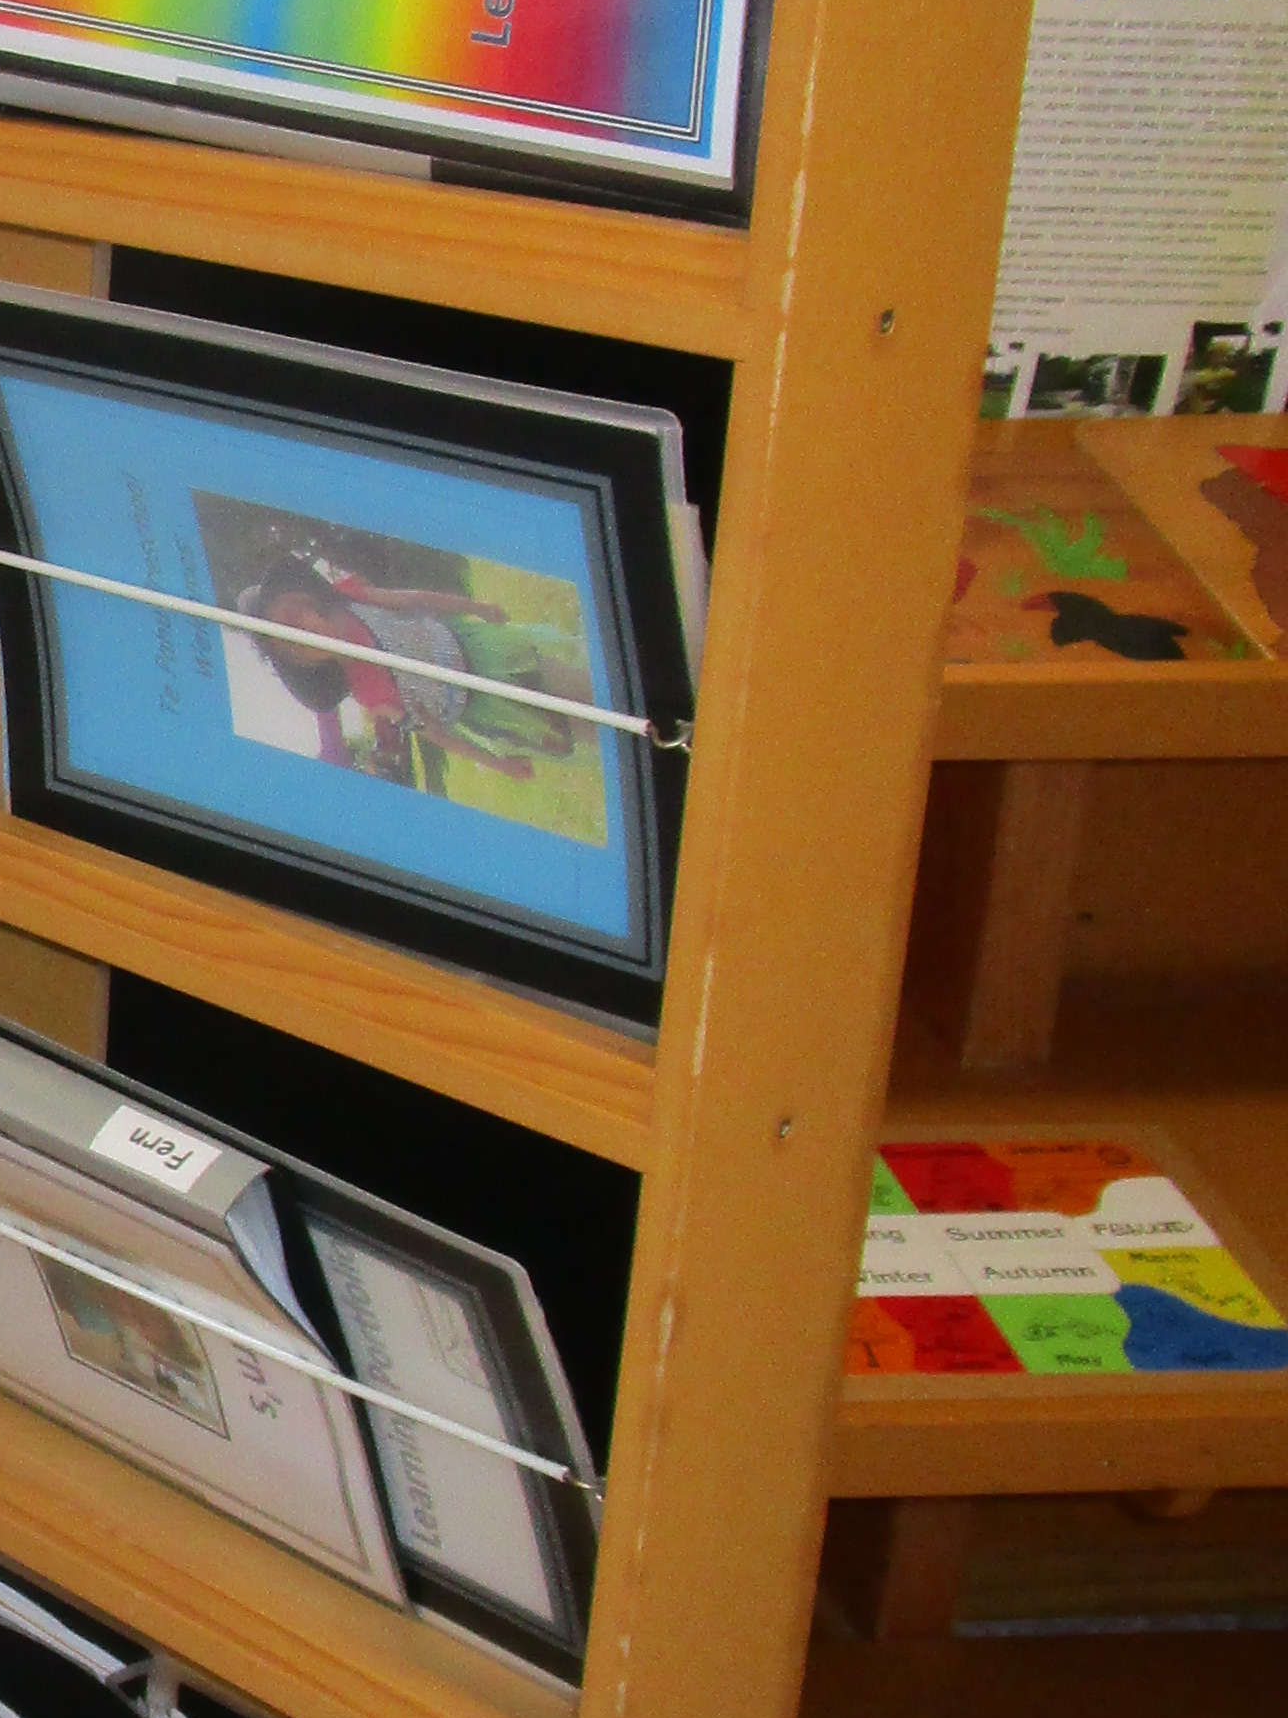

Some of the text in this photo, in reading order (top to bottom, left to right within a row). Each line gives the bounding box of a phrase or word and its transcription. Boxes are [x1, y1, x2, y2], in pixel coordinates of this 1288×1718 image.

[127, 1125, 195, 1172] Fern
[946, 1224, 1066, 1243] Summer
[981, 1264, 1097, 1284] Autumn
